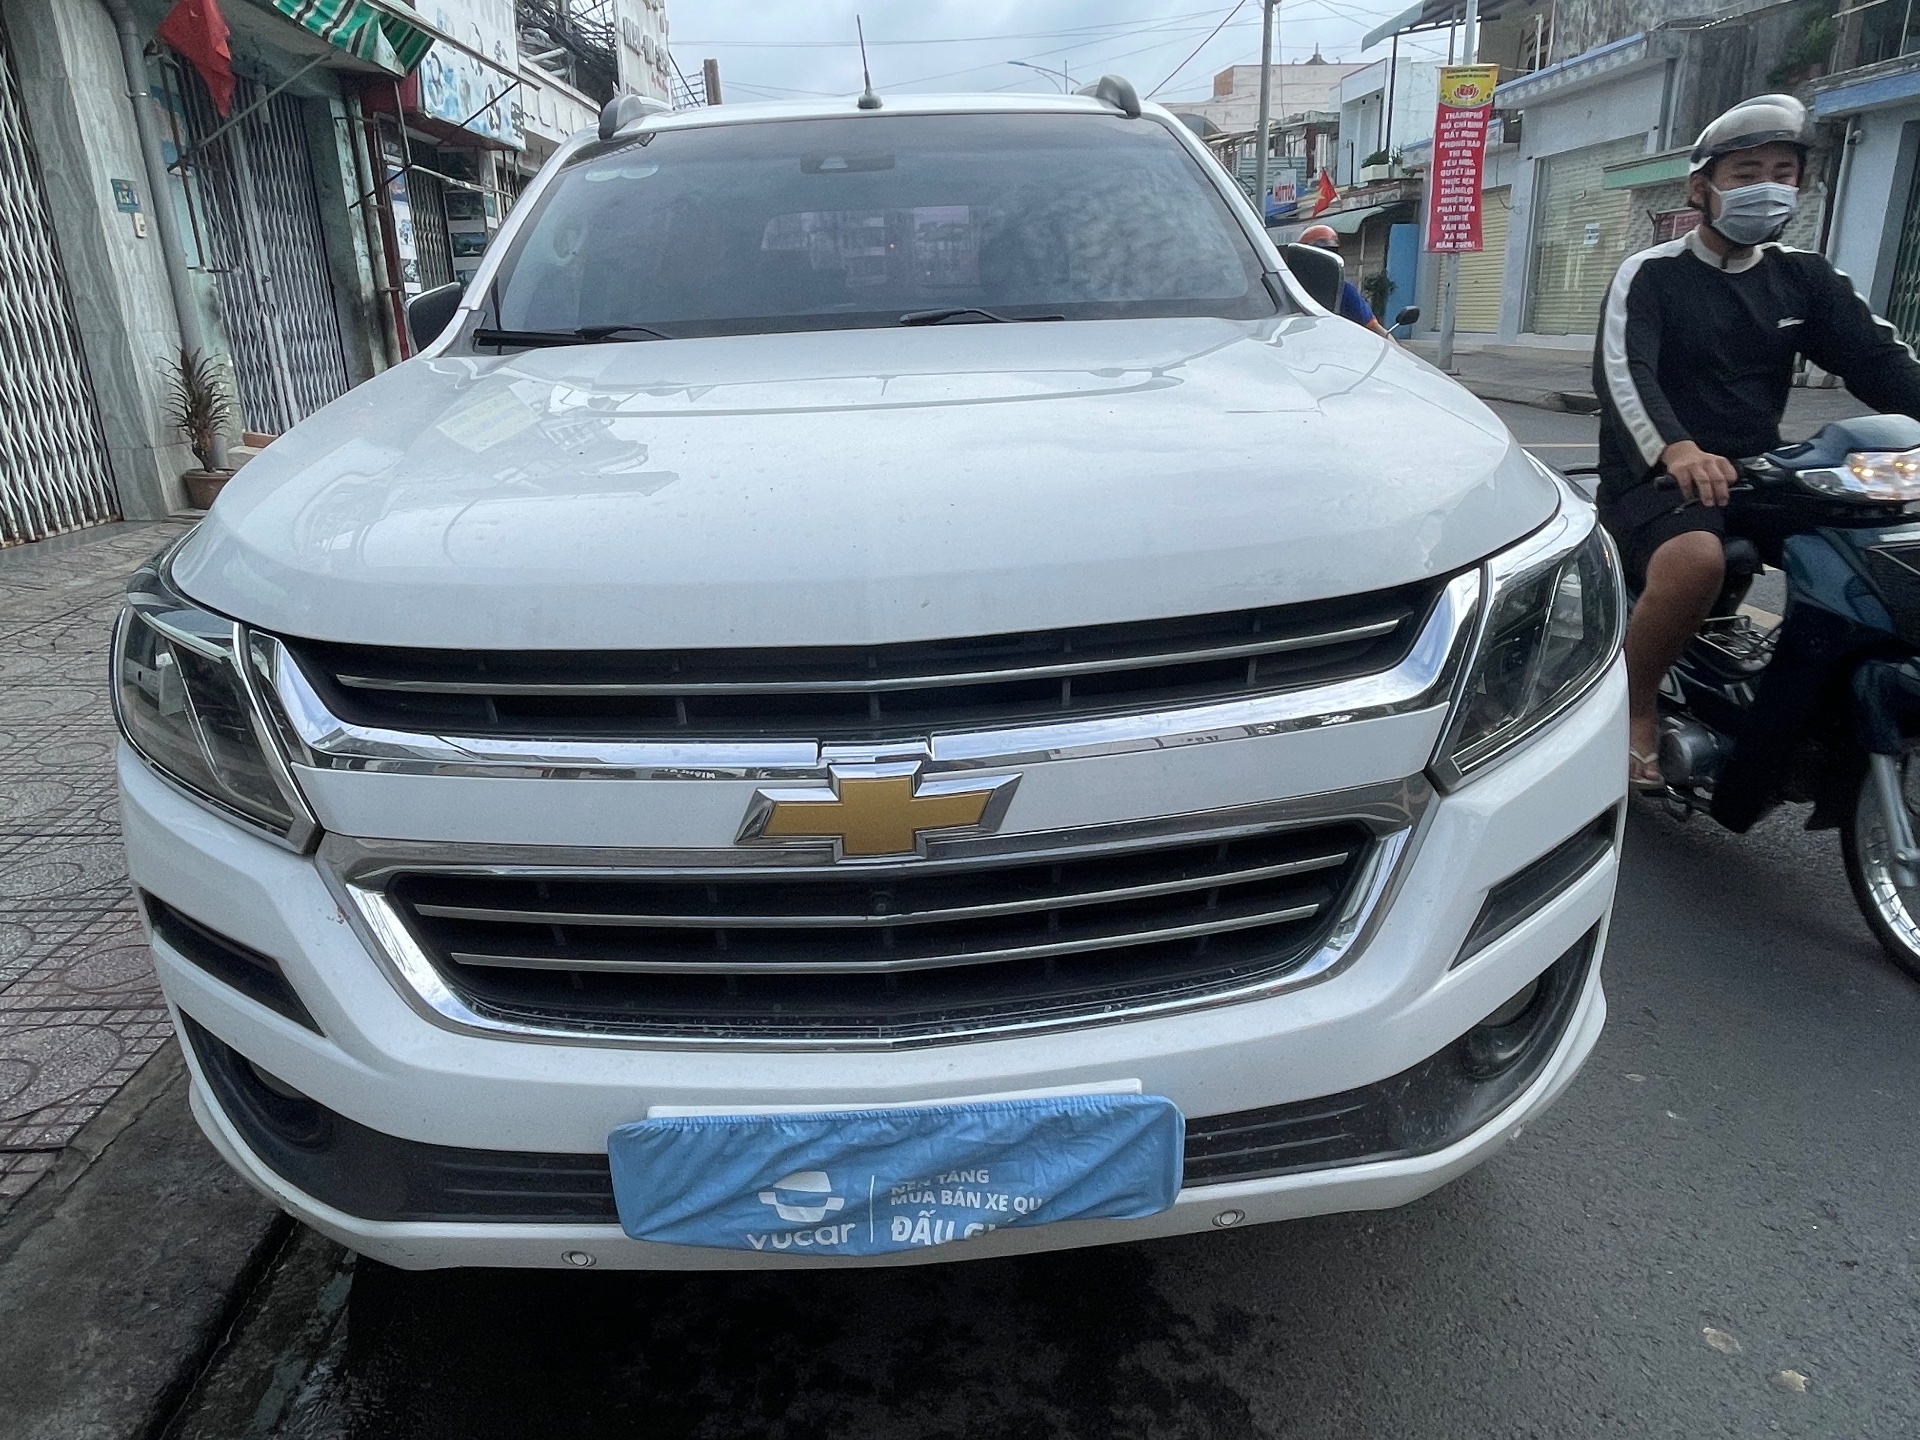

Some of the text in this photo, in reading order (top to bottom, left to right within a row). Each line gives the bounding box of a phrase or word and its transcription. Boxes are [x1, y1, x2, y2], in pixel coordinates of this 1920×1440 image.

[890, 1190, 936, 1206] MUA
[940, 1186, 981, 1209] BÁN
[985, 1192, 1008, 1212] XE
[746, 1223, 857, 1250] vucar
[890, 1209, 955, 1246] ĐẤU
